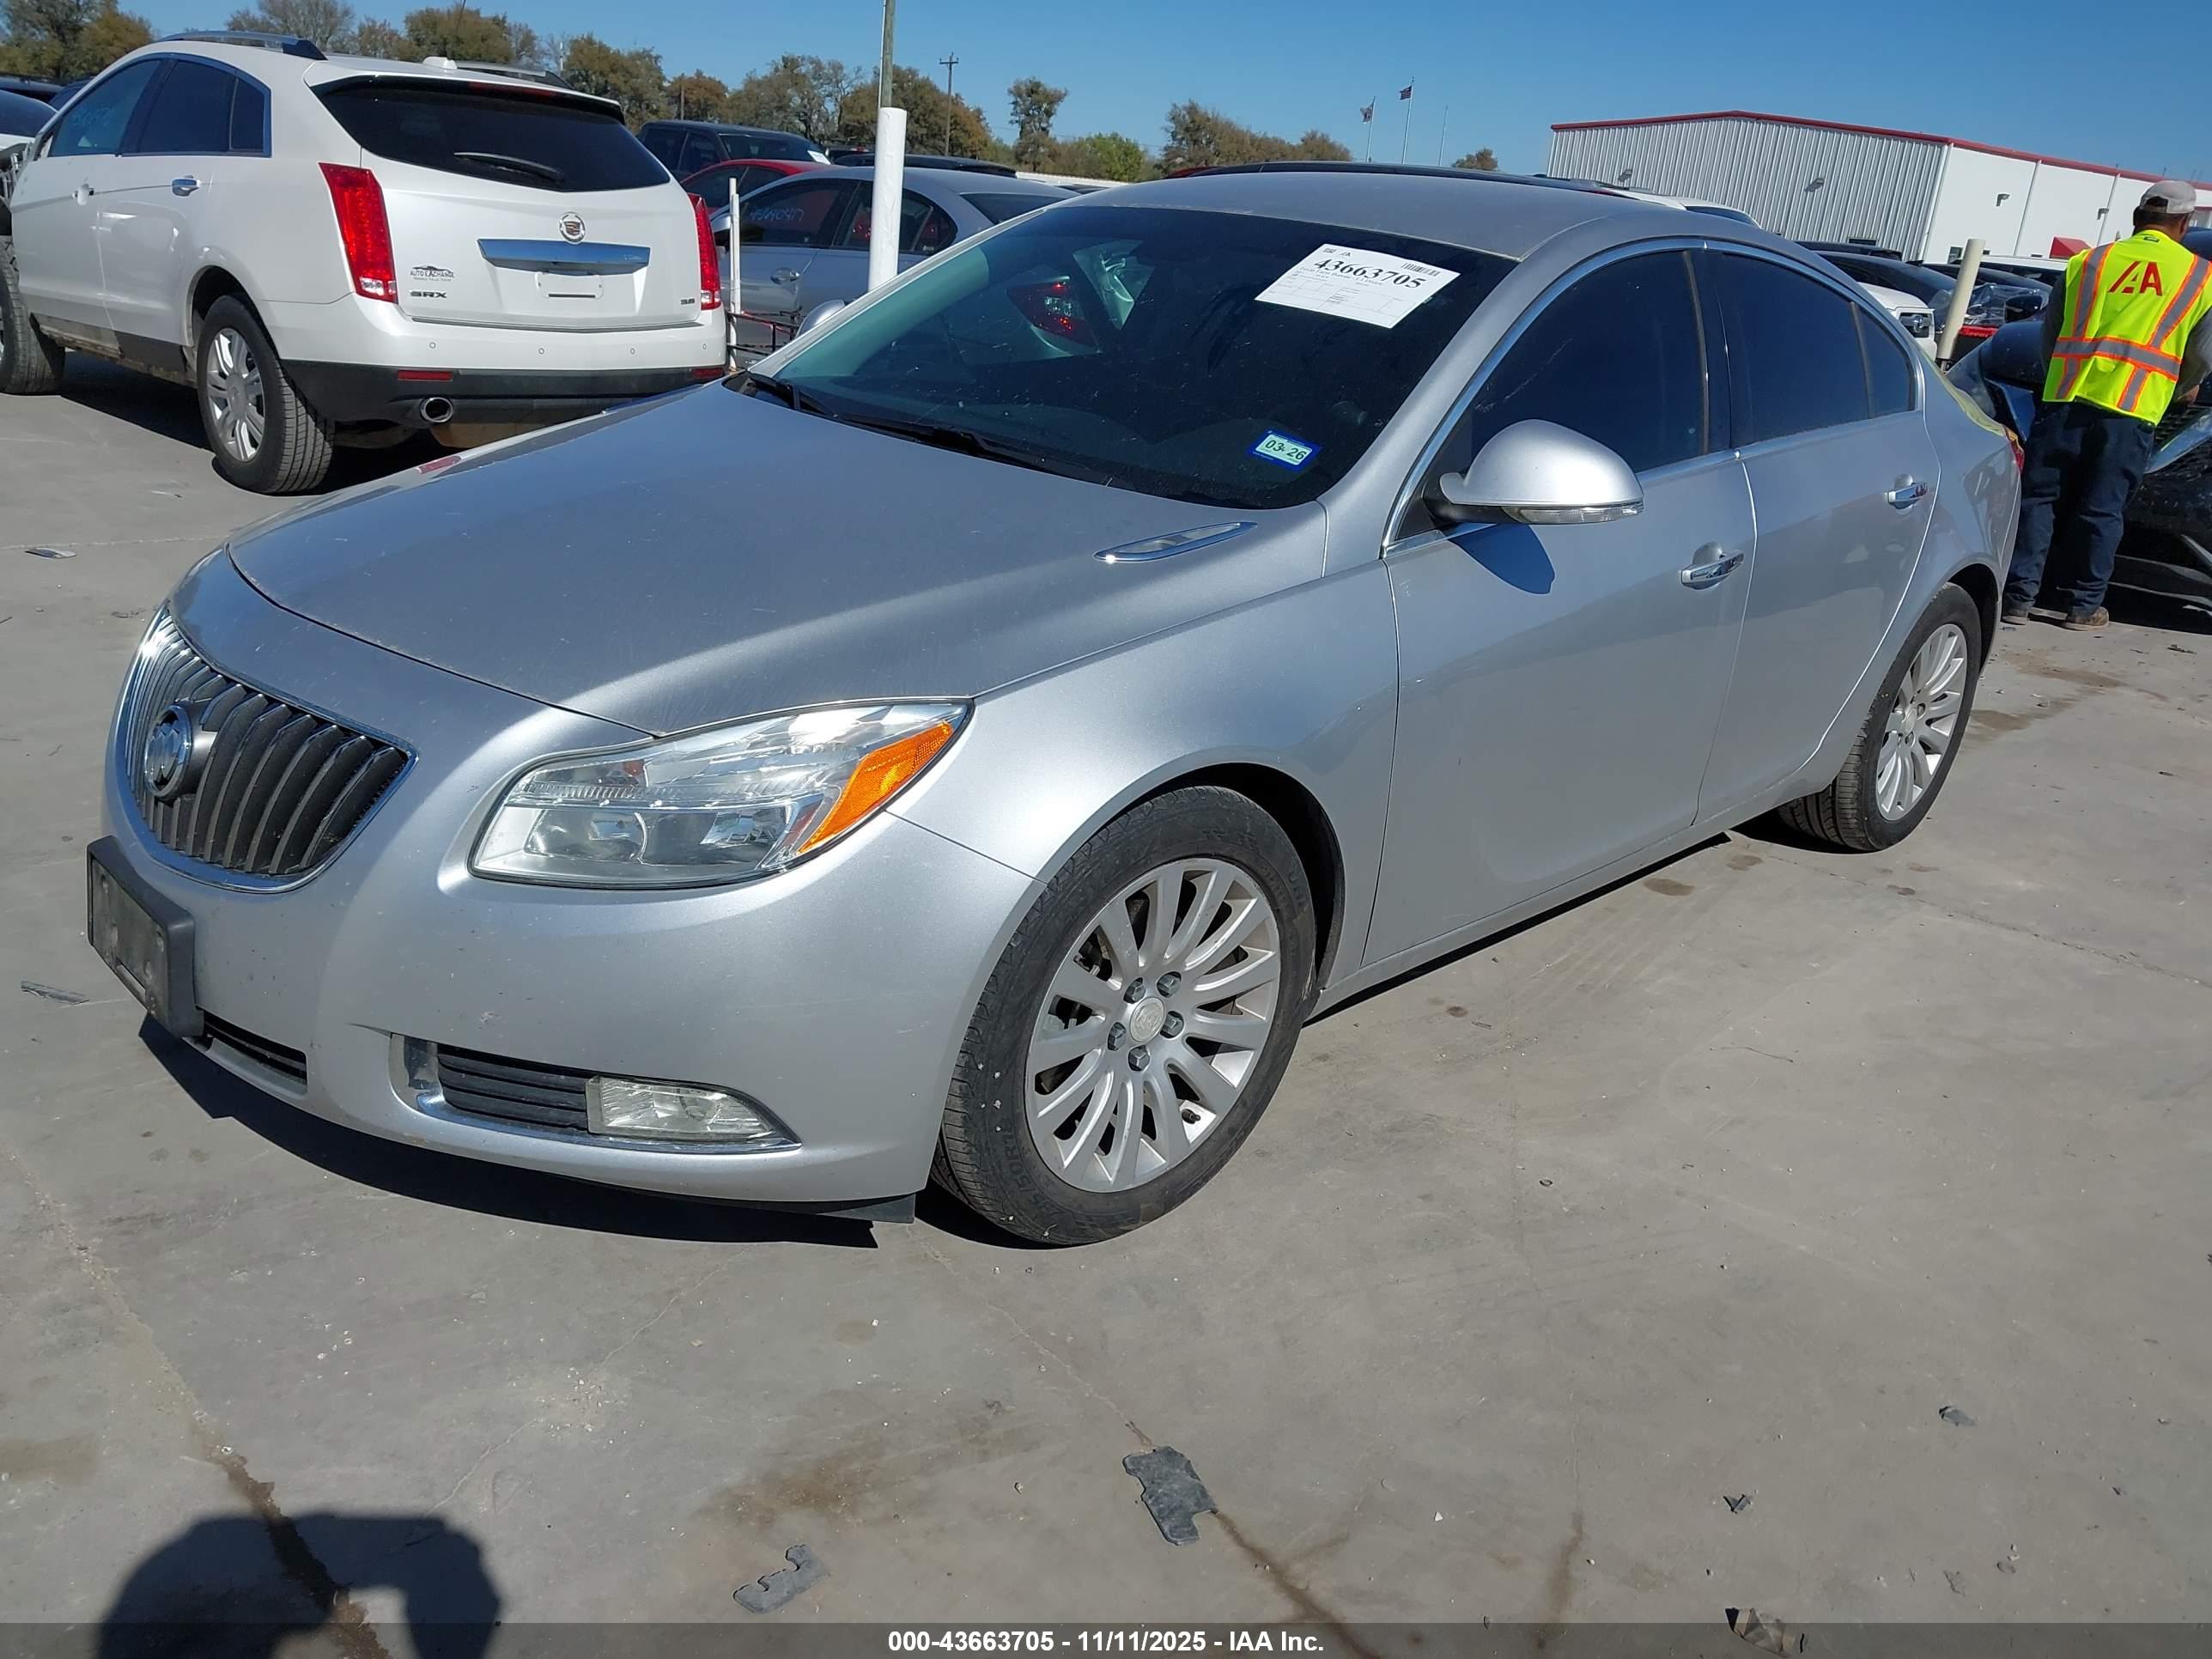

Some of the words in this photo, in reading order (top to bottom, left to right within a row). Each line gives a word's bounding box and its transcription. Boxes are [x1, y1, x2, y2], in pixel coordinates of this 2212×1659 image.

[1314, 258, 1427, 289] 43663705
[1265, 440, 1285, 452] 03
[1286, 447, 1307, 460] 26
